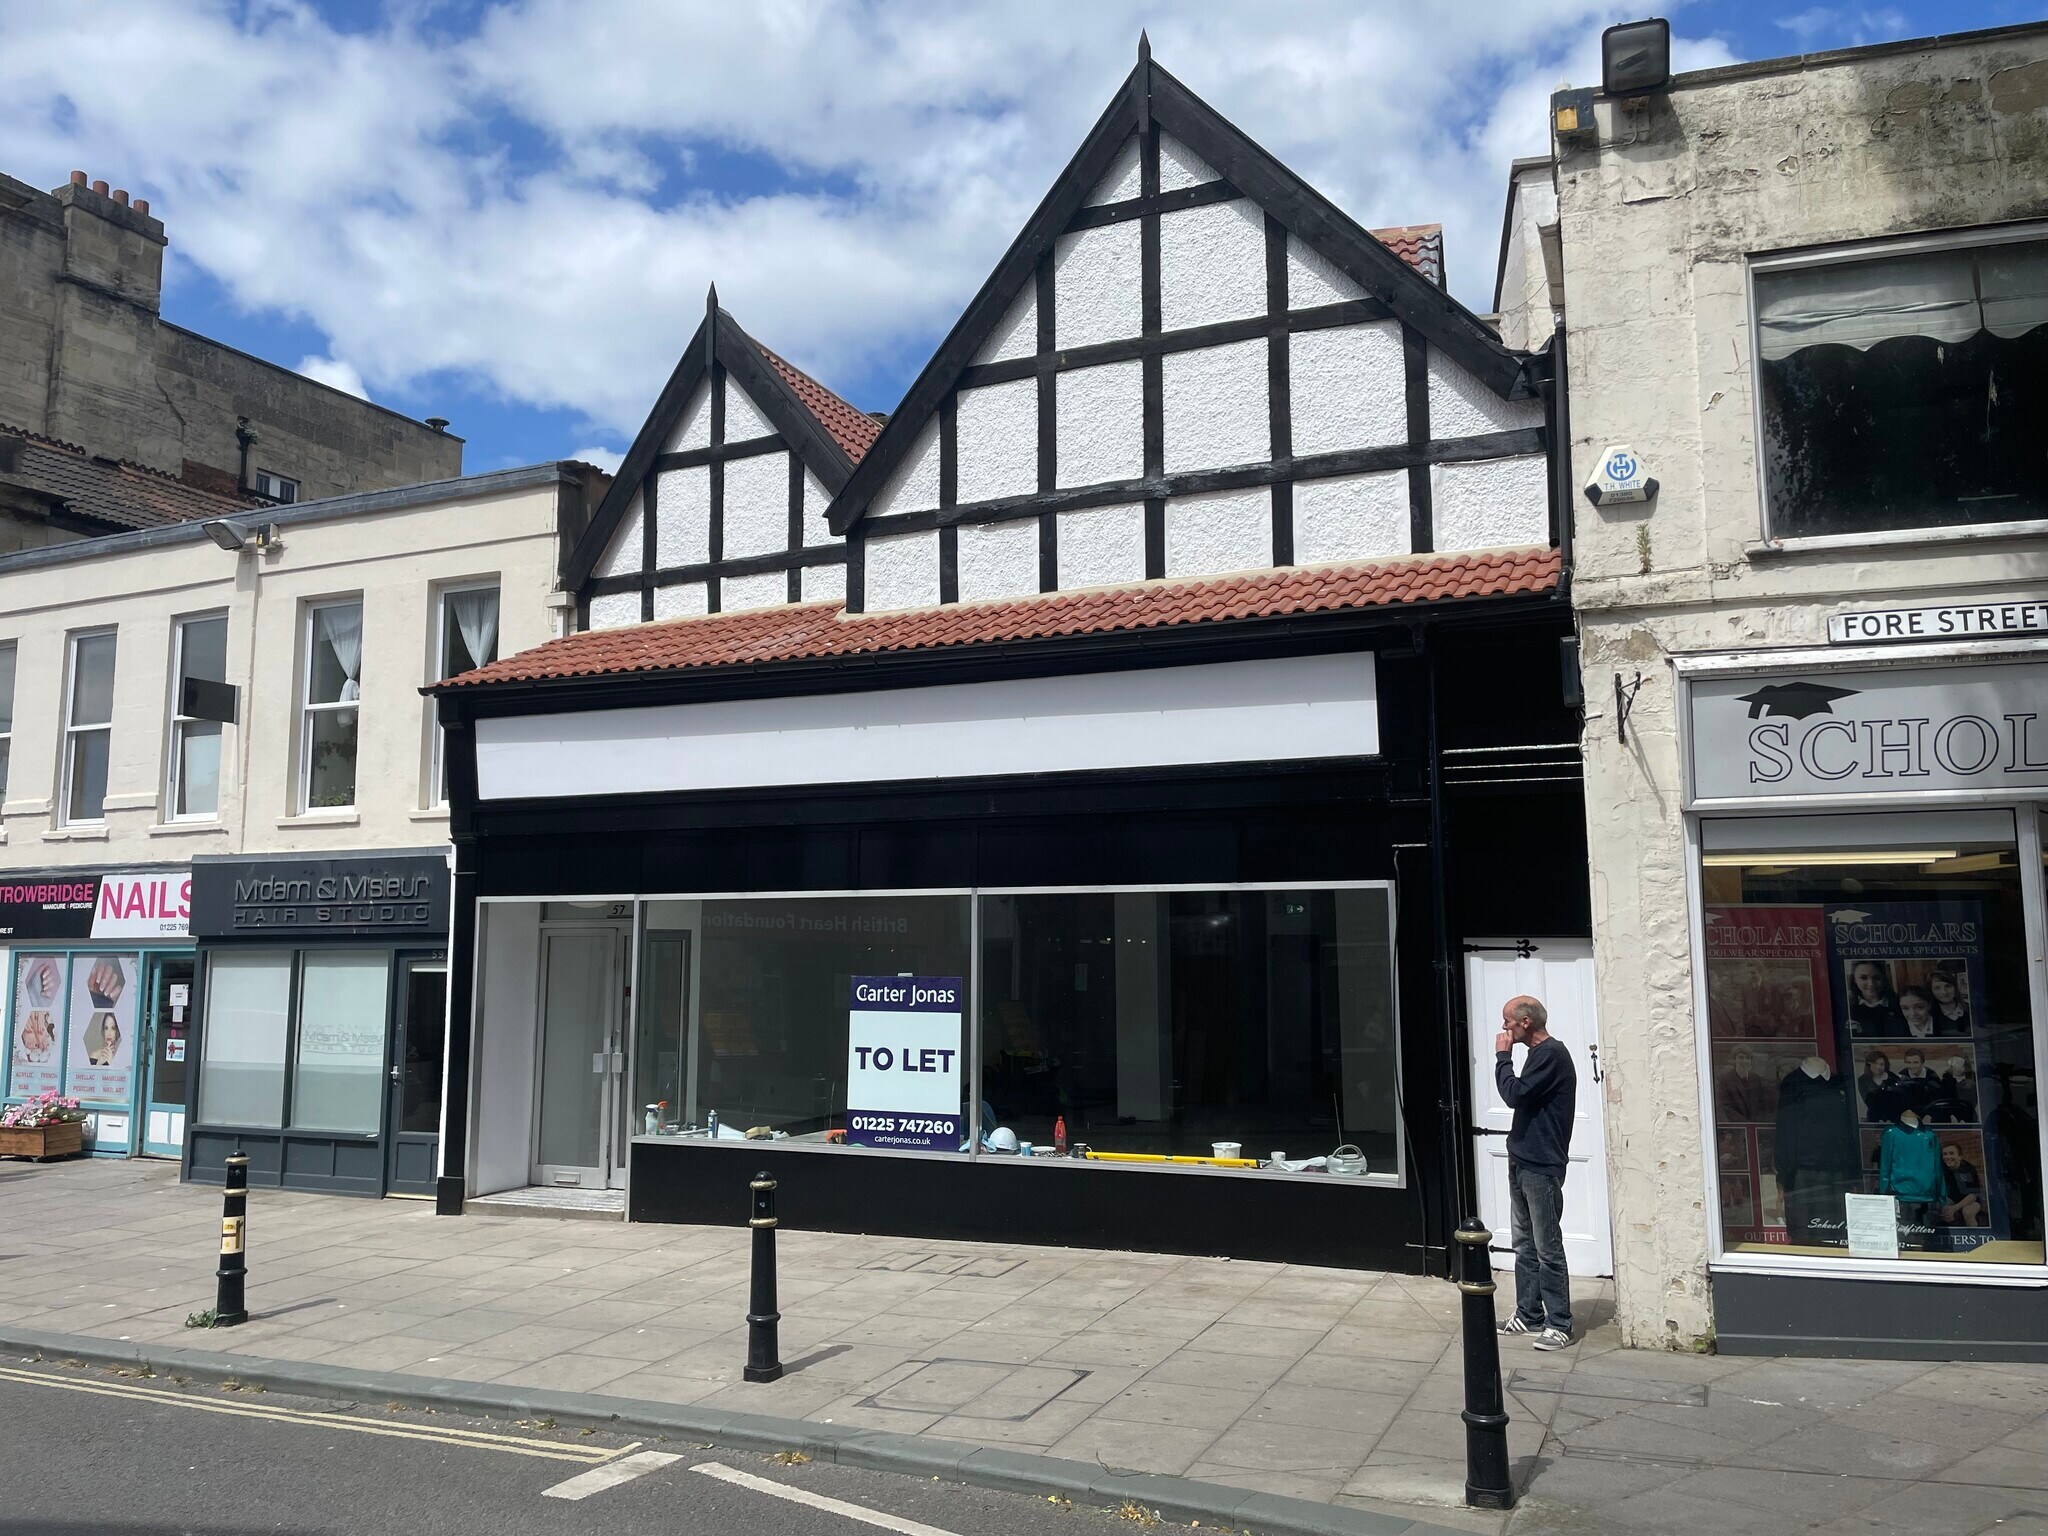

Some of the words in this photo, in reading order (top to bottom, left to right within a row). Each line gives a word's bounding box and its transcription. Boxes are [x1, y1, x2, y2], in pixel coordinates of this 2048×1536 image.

[1618, 480, 1641, 489] WHITE
[1844, 610, 1924, 638] FORE
[1749, 713, 2048, 784] SCHOL
[0, 883, 94, 904] TROWBRIDGE
[316, 876, 337, 899] &
[100, 879, 192, 920] NAILS
[233, 907, 298, 923] HAIR
[316, 905, 430, 922] STUDIO
[612, 905, 625, 915] 57
[159, 923, 177, 931] 01225
[1834, 922, 1977, 945] SCHOLARS
[431, 950, 444, 960] 59
[1760, 947, 1821, 957] SPECIALISTS
[1836, 947, 1910, 956] SCHOOLWEAR
[1912, 945, 1978, 955] SPECIALISTS
[856, 984, 907, 1002] Carter
[908, 984, 955, 1007] Jonas
[855, 1047, 894, 1071] TO
[902, 1048, 956, 1073] LET
[851, 1116, 895, 1132] 01225
[898, 1118, 955, 1135] 747260
[874, 1135, 931, 1145] carterjonas.co.uk
[1807, 1217, 1846, 1230] School
